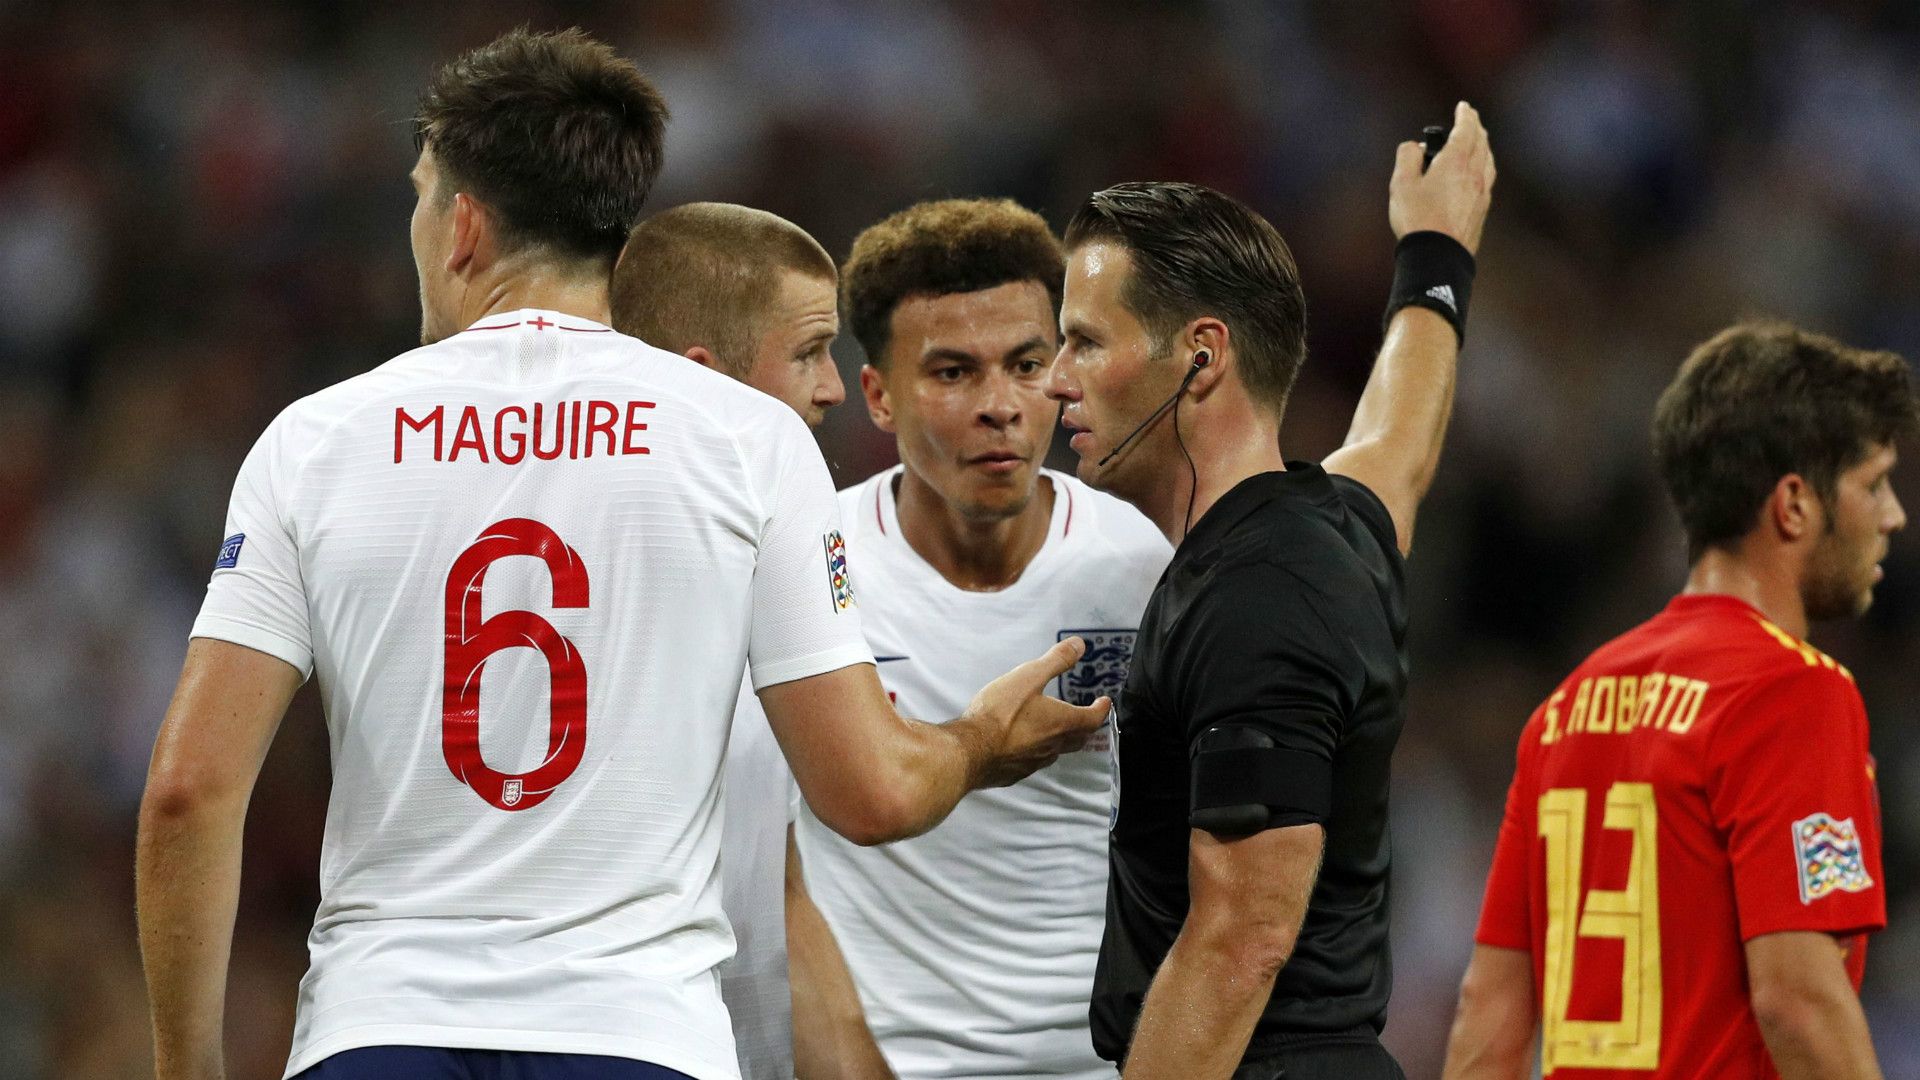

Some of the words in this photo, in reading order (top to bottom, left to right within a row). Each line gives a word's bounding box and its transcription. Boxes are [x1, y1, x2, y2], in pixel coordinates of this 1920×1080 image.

[394, 401, 657, 465] MAGUIRE
[442, 517, 590, 811] 6
[1538, 781, 1663, 1078] 13
